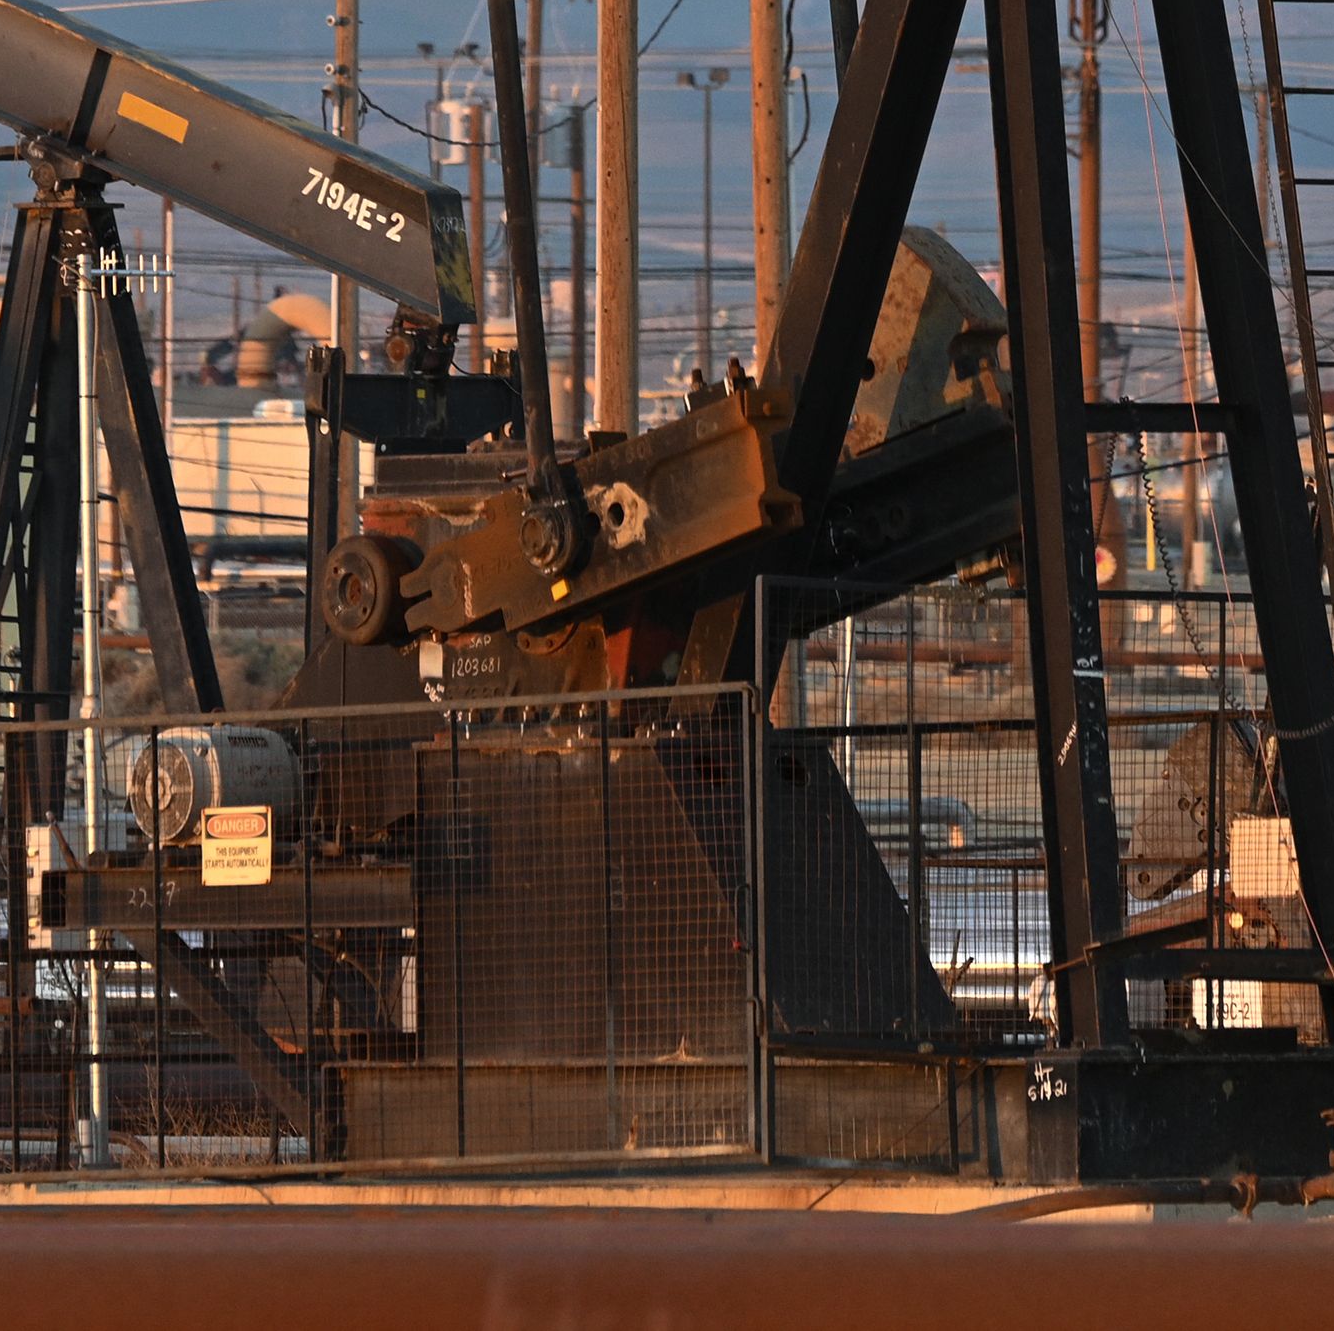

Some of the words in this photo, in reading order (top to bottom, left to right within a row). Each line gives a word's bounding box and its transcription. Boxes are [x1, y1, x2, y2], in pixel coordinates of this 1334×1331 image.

[301, 167, 406, 243] 7194E-2
[451, 657, 501, 679] 1203681
[214, 819, 260, 833] DANGER
[228, 846, 259, 857] EQUIPMENT
